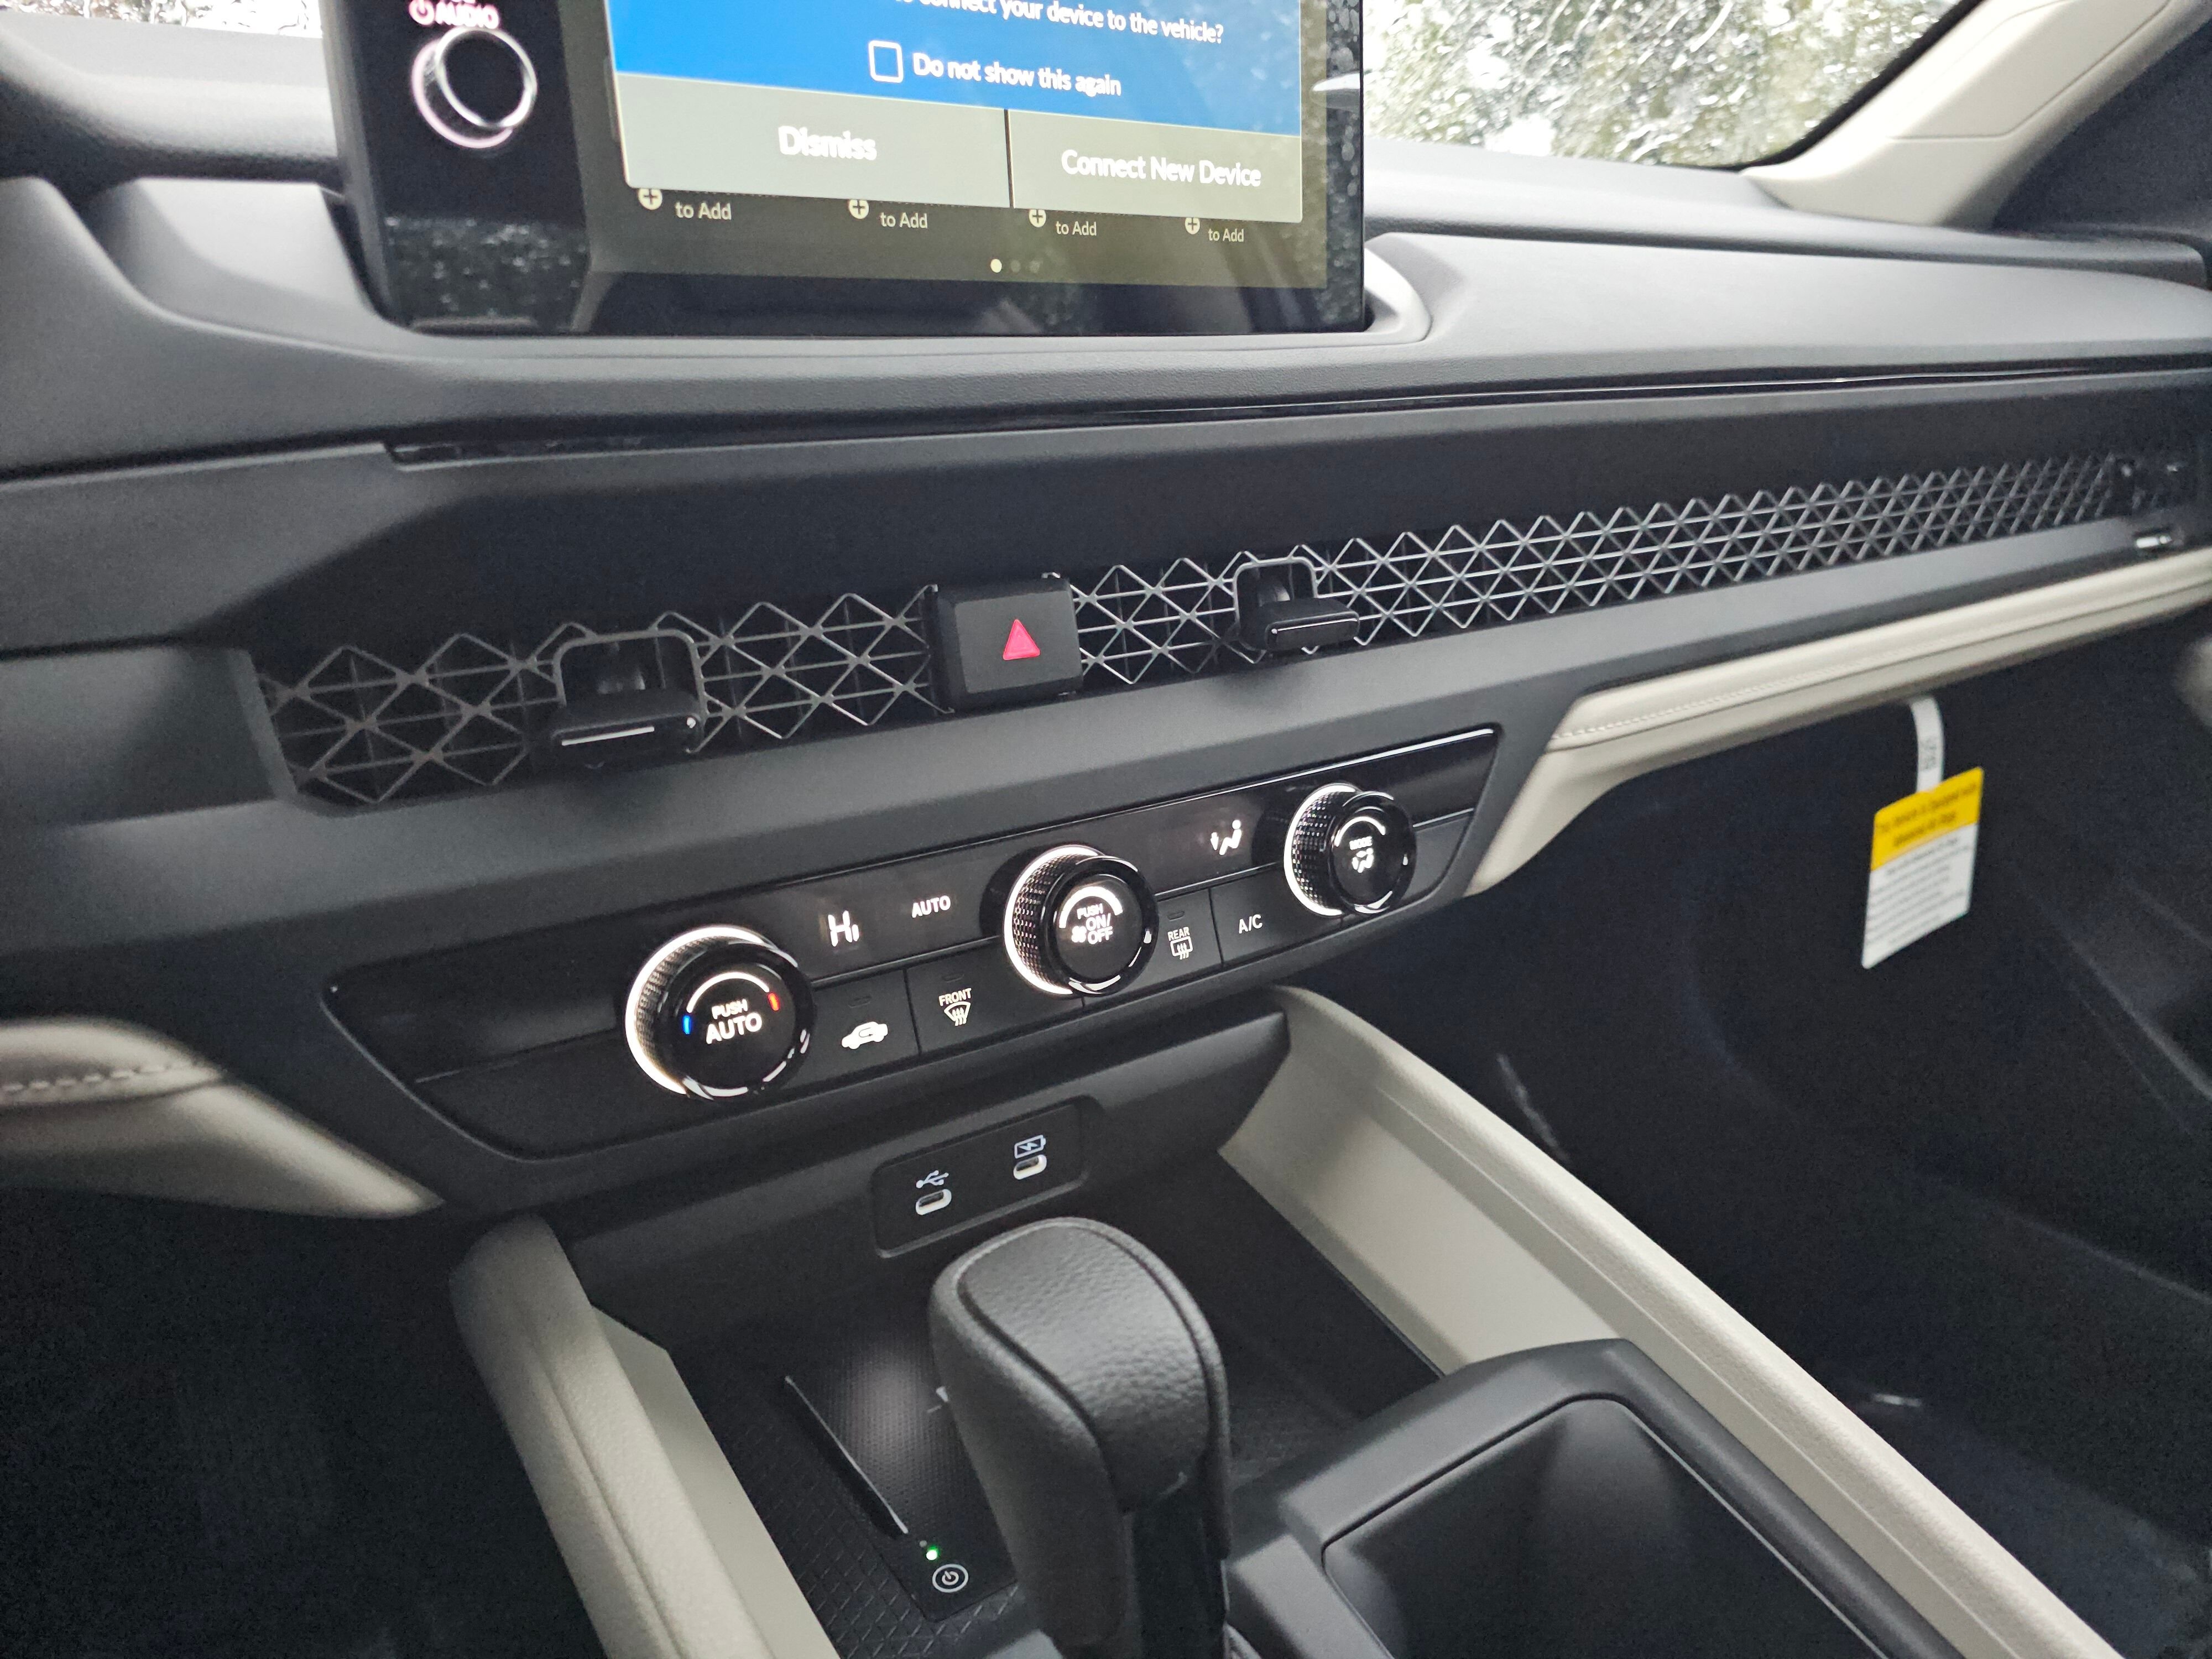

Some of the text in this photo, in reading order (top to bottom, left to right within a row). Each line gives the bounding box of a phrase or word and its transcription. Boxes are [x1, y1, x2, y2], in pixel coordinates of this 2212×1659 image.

[435, 1, 499, 29] AUDIO
[1000, 0, 1043, 20] your
[1047, 0, 1104, 28] device
[1107, 9, 1126, 30] to
[1129, 12, 1158, 35] the
[1161, 18, 1224, 44] vehicle?
[913, 52, 1121, 97] Do not show this again
[778, 125, 877, 160] Dismiss
[1061, 149, 1261, 186] Connect New Device
[675, 201, 732, 221] to Add
[880, 212, 928, 229] to Add
[1056, 221, 1097, 236] to Add
[1208, 228, 1244, 242] to Add
[912, 895, 951, 918] AUTO
[1077, 903, 1103, 920] PUSH
[1086, 912, 1111, 931] ON/
[1238, 914, 1262, 934] A/C
[1088, 926, 1113, 945] OFF
[1167, 926, 1190, 941] REAR
[938, 988, 972, 1006] FRONT
[712, 999, 748, 1020] PUSH
[706, 1012, 763, 1044] AUTO
